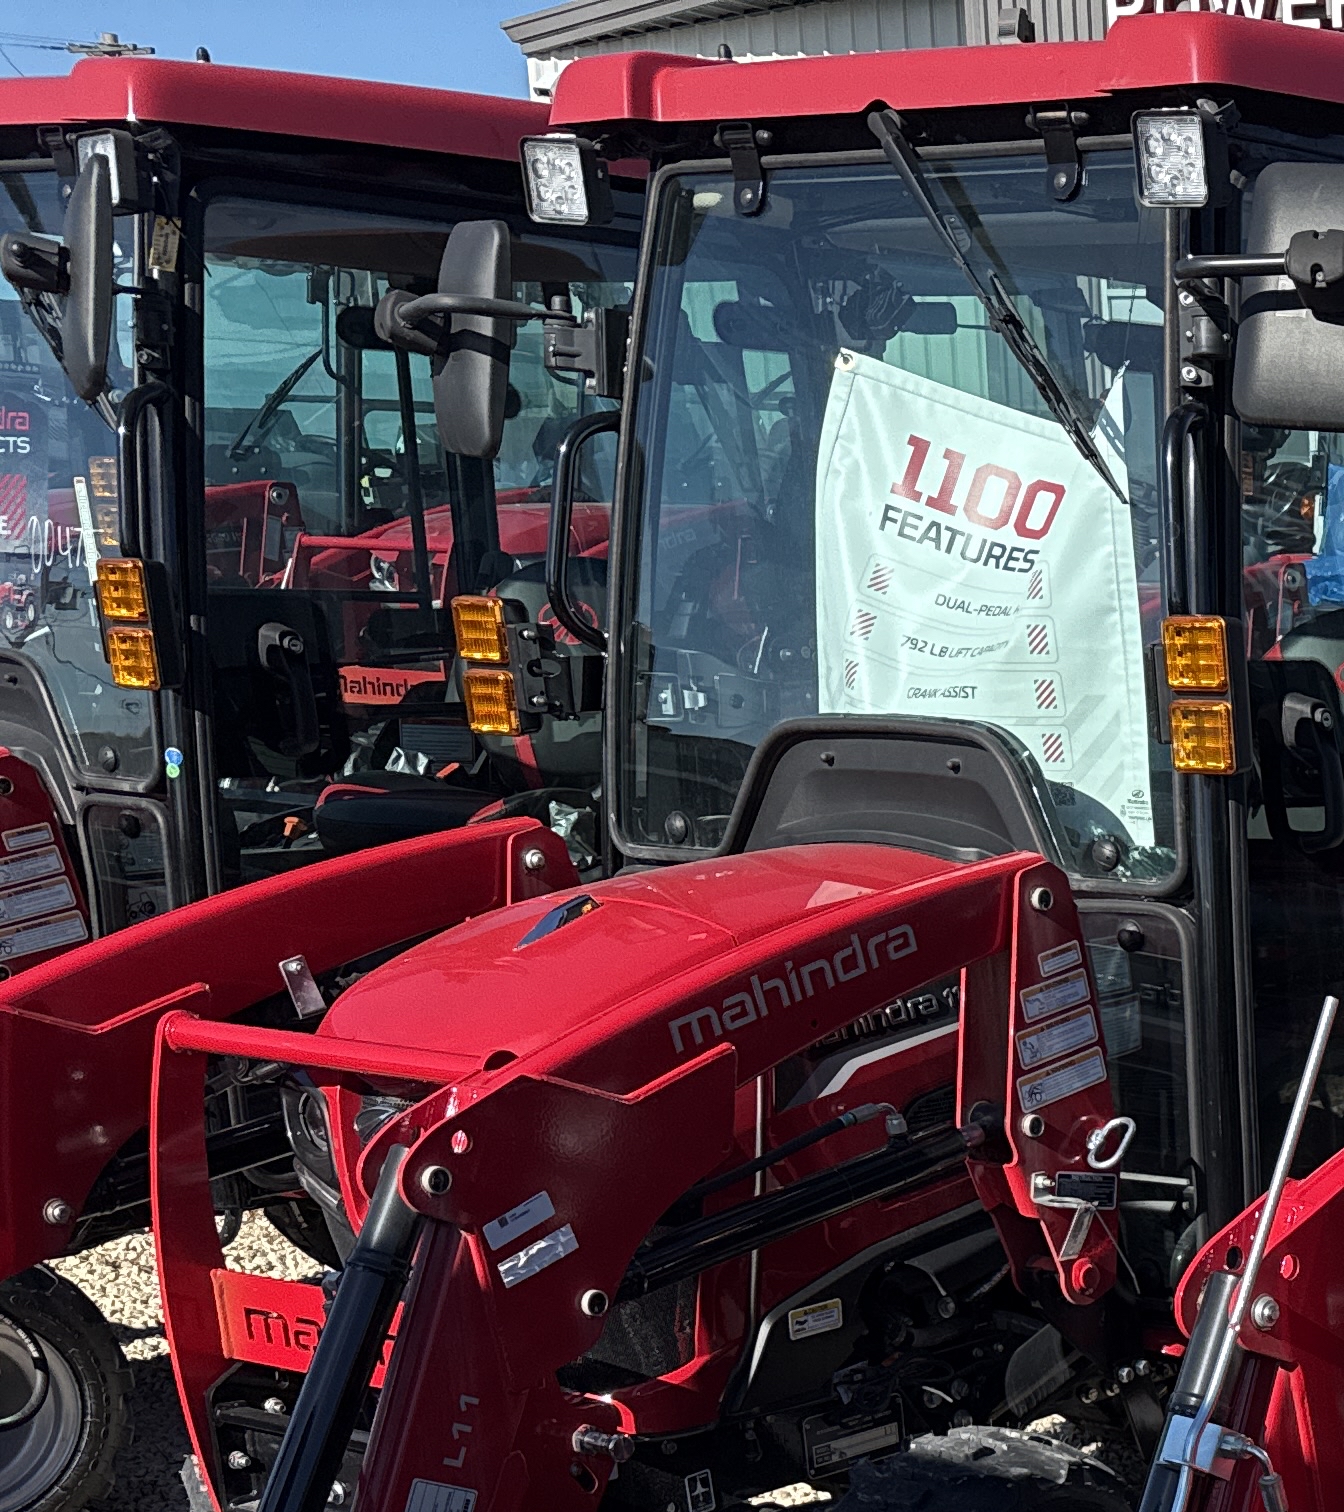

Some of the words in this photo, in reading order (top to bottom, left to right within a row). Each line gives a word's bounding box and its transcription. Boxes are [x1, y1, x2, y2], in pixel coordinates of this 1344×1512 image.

[890, 434, 1066, 540] 1100
[878, 503, 1040, 574] FEATURES
[935, 593, 1013, 617] DUAL-PEDAL
[900, 634, 929, 653] 792
[930, 643, 949, 658] LB
[941, 685, 978, 699] ASSIST
[668, 924, 918, 1054] mahindra
[443, 1394, 480, 1468] L11
